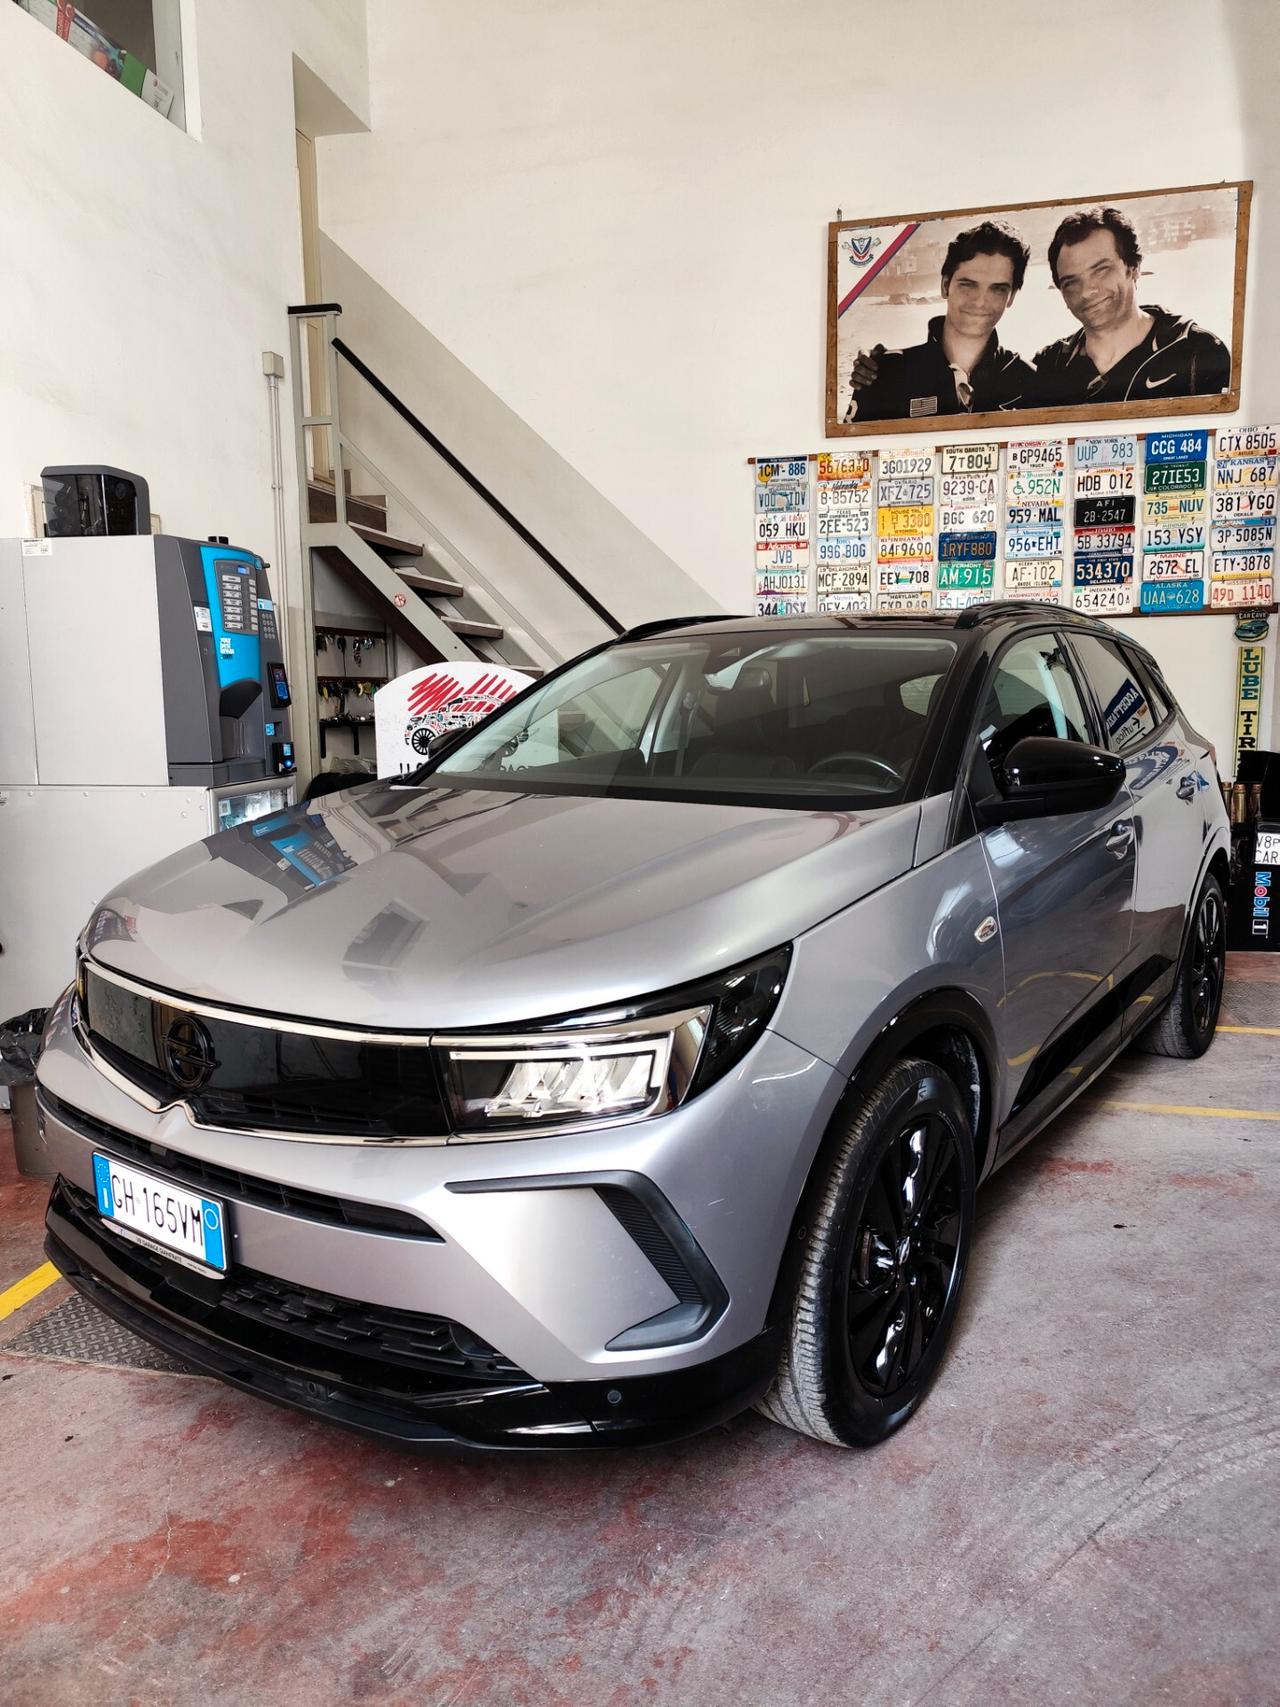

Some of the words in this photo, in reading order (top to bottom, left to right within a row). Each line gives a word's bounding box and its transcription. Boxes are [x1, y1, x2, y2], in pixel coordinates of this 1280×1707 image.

[1152, 440, 1176, 455] CCG
[1180, 438, 1202, 453] 484
[1219, 436, 1241, 452] CTX
[1246, 433, 1276, 450] 8505
[1077, 446, 1099, 462] UUP
[1111, 442, 1134, 459] 983
[1230, 458, 1265, 466] KANSAS
[1078, 475, 1101, 492] HDB
[1110, 472, 1133, 490] 012
[1218, 468, 1242, 485] NNJ
[1250, 466, 1275, 482] 687
[910, 484, 931, 500] 725
[1028, 478, 1060, 495] 952N
[1147, 501, 1168, 515] 735
[1180, 499, 1204, 513] NUV
[1216, 496, 1240, 513] 381
[760, 524, 779, 538] 059
[786, 522, 806, 536] HKU
[1147, 530, 1171, 547] 153
[1179, 527, 1203, 544] YSY
[1009, 538, 1031, 552] 956
[1038, 536, 1061, 551] EHT
[1097, 533, 1132, 549] 33794
[772, 550, 793, 564] JVB
[820, 545, 841, 560] 996
[1077, 562, 1130, 580] 534370
[1150, 560, 1178, 576] 2672
[1186, 558, 1199, 574] EL
[909, 571, 929, 585] 708
[1144, 590, 1166, 606] UAA
[1176, 588, 1200, 604] 628
[758, 603, 778, 617] 344
[1240, 648, 1260, 700] LUBE
[1253, 872, 1272, 917] Mobil
